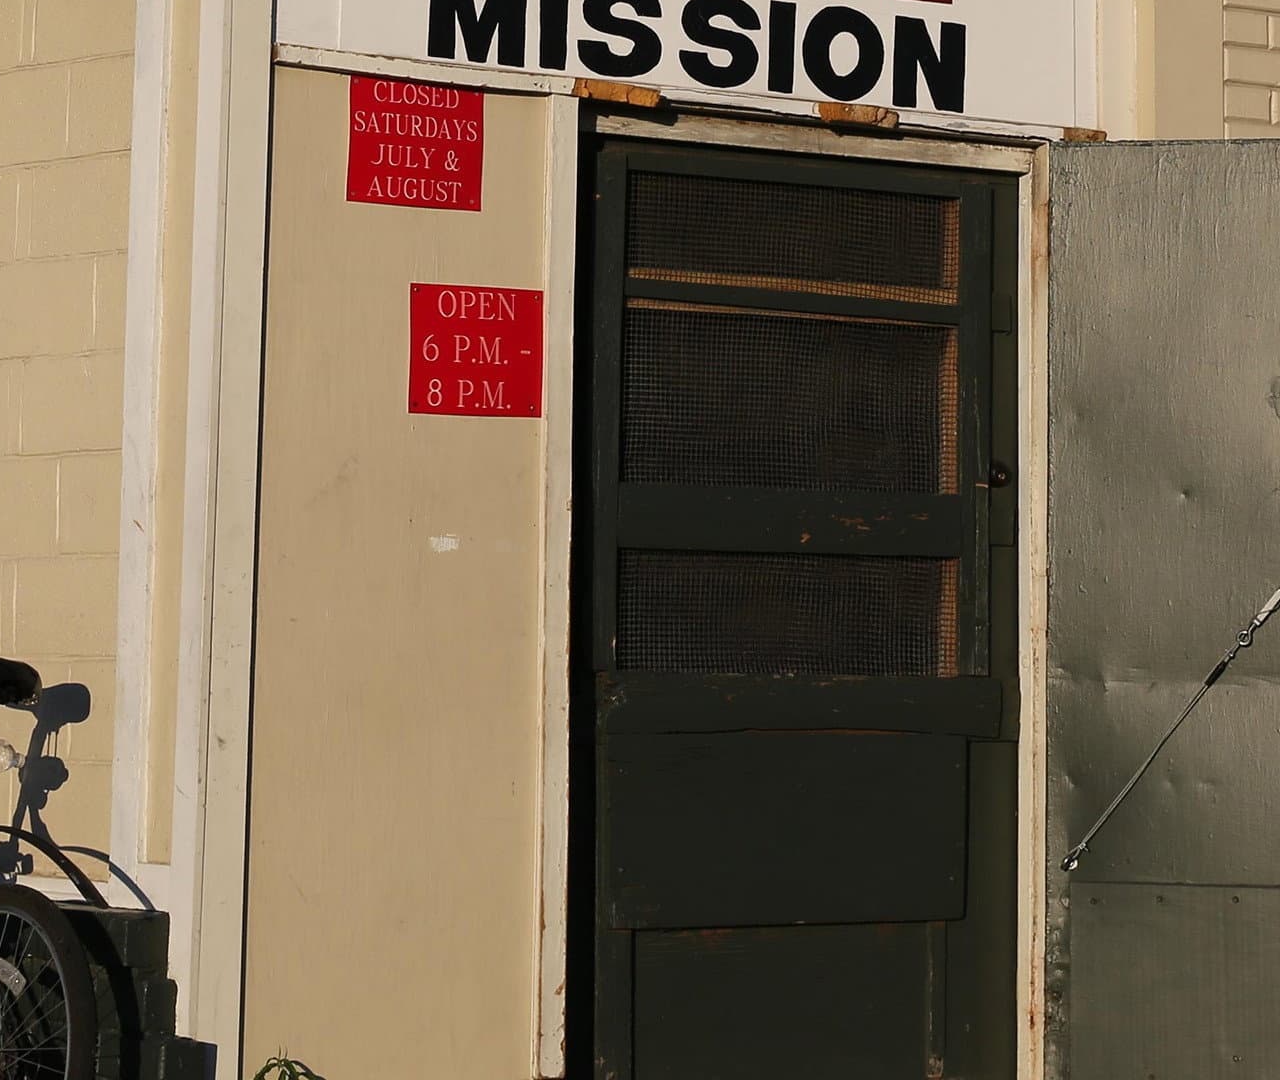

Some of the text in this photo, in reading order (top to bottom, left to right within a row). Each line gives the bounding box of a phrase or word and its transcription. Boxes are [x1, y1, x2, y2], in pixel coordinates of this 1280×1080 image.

[373, 80, 460, 110] CLOSED
[354, 110, 478, 143] SATURDAYS
[371, 143, 460, 172] JULY &
[367, 175, 462, 204] AUGUST
[438, 290, 517, 321] OPEN
[422, 333, 440, 363] 6
[453, 335, 509, 366] P.M.
[426, 378, 512, 410] 8 P.M.
